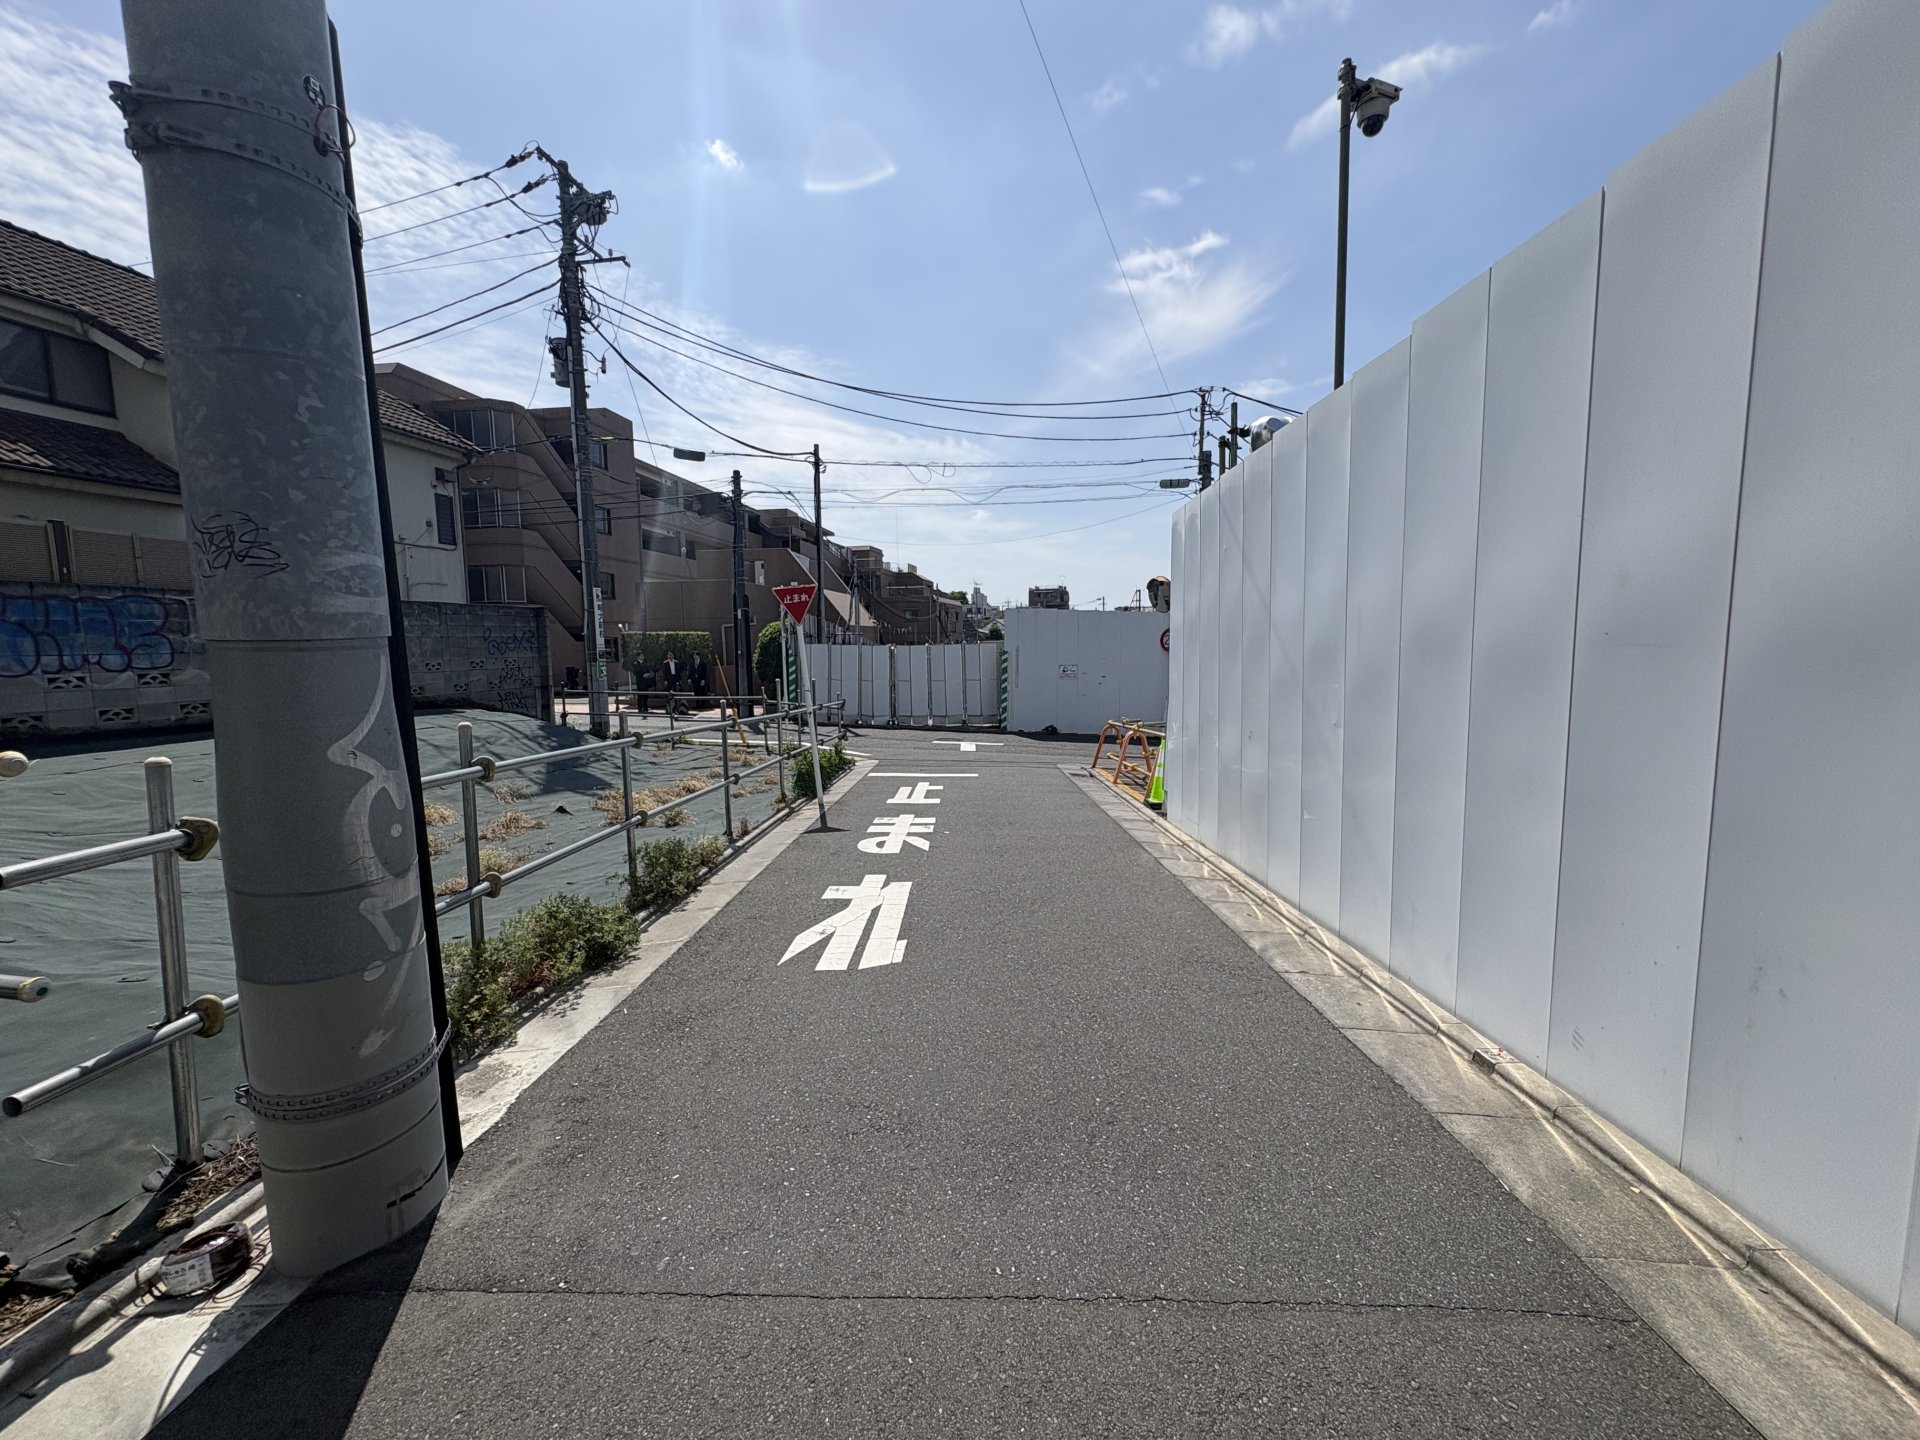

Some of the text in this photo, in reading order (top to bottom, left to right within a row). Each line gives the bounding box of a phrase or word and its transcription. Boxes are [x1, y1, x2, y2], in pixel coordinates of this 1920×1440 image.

[783, 592, 810, 604] 止まれ
[777, 782, 944, 971] 止まれ
